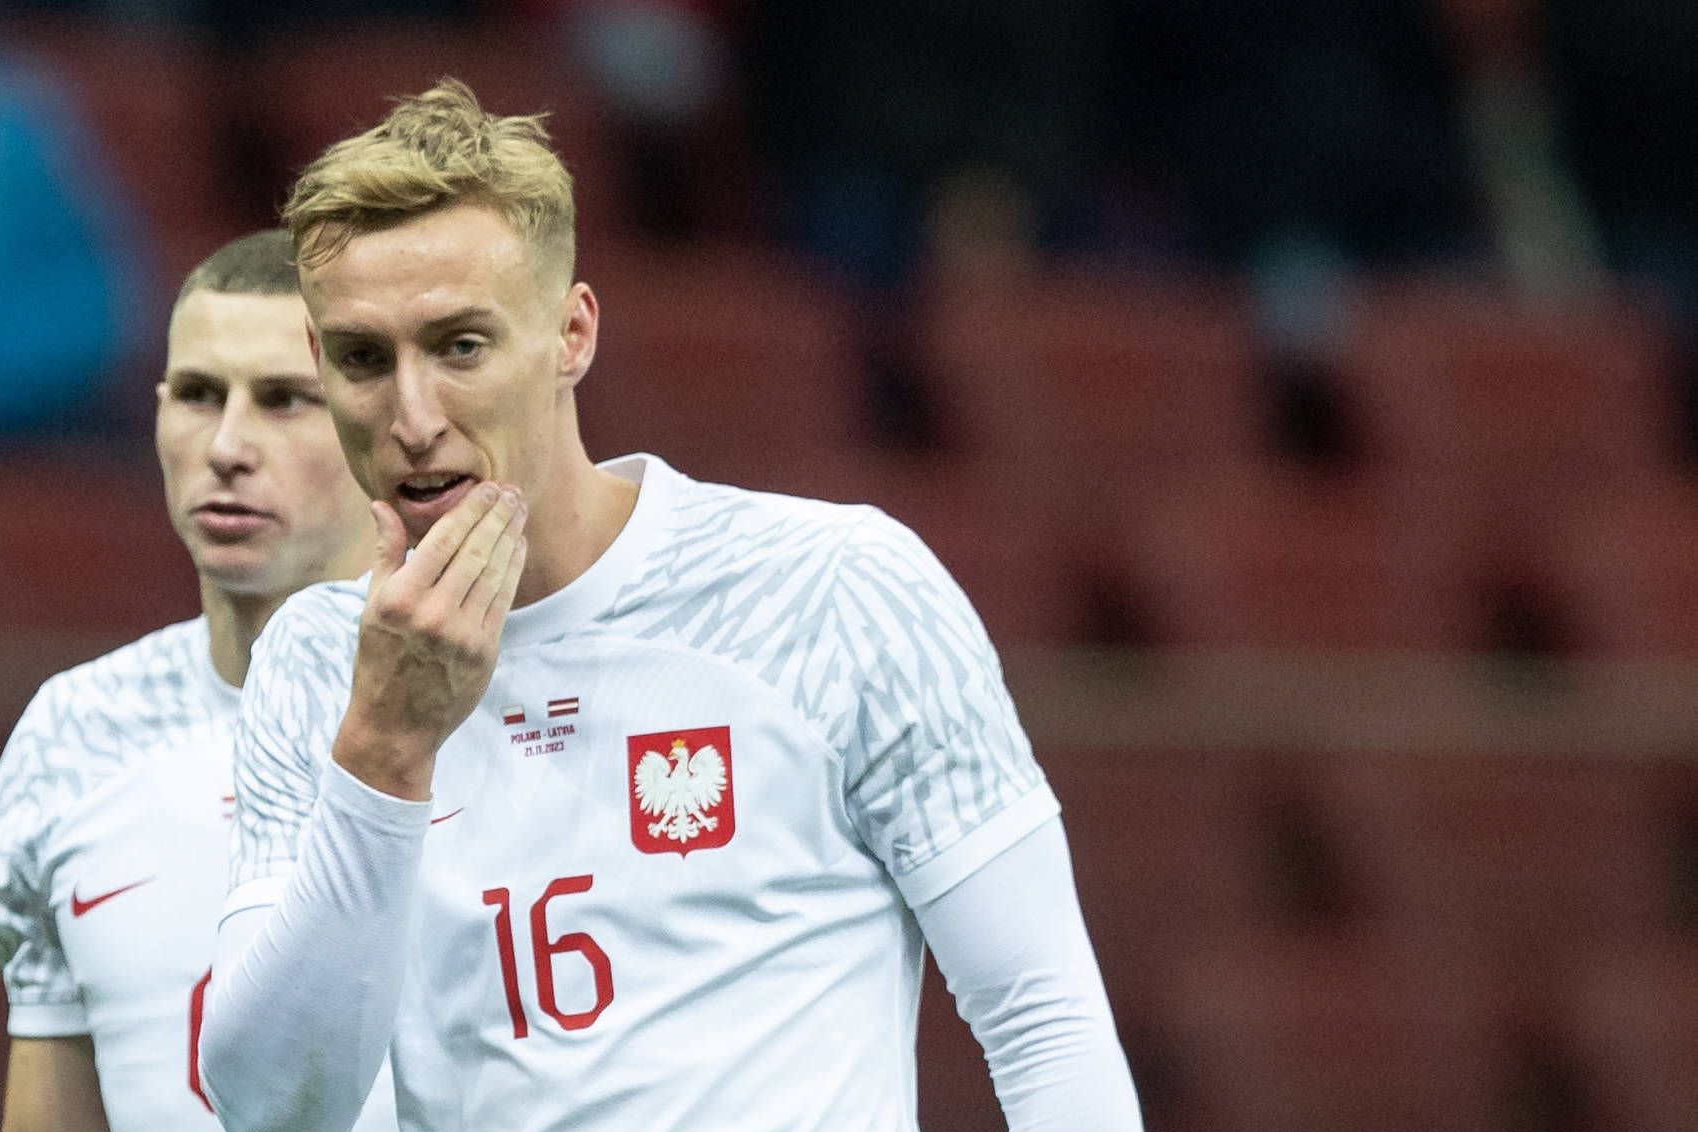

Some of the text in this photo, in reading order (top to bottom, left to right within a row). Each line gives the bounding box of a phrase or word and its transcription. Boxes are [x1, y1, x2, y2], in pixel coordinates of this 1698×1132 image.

[510, 730, 542, 744] POLAND
[547, 724, 576, 738] LATVIA
[524, 741, 565, 757] 21.11.2023
[482, 874, 614, 1040] 16
